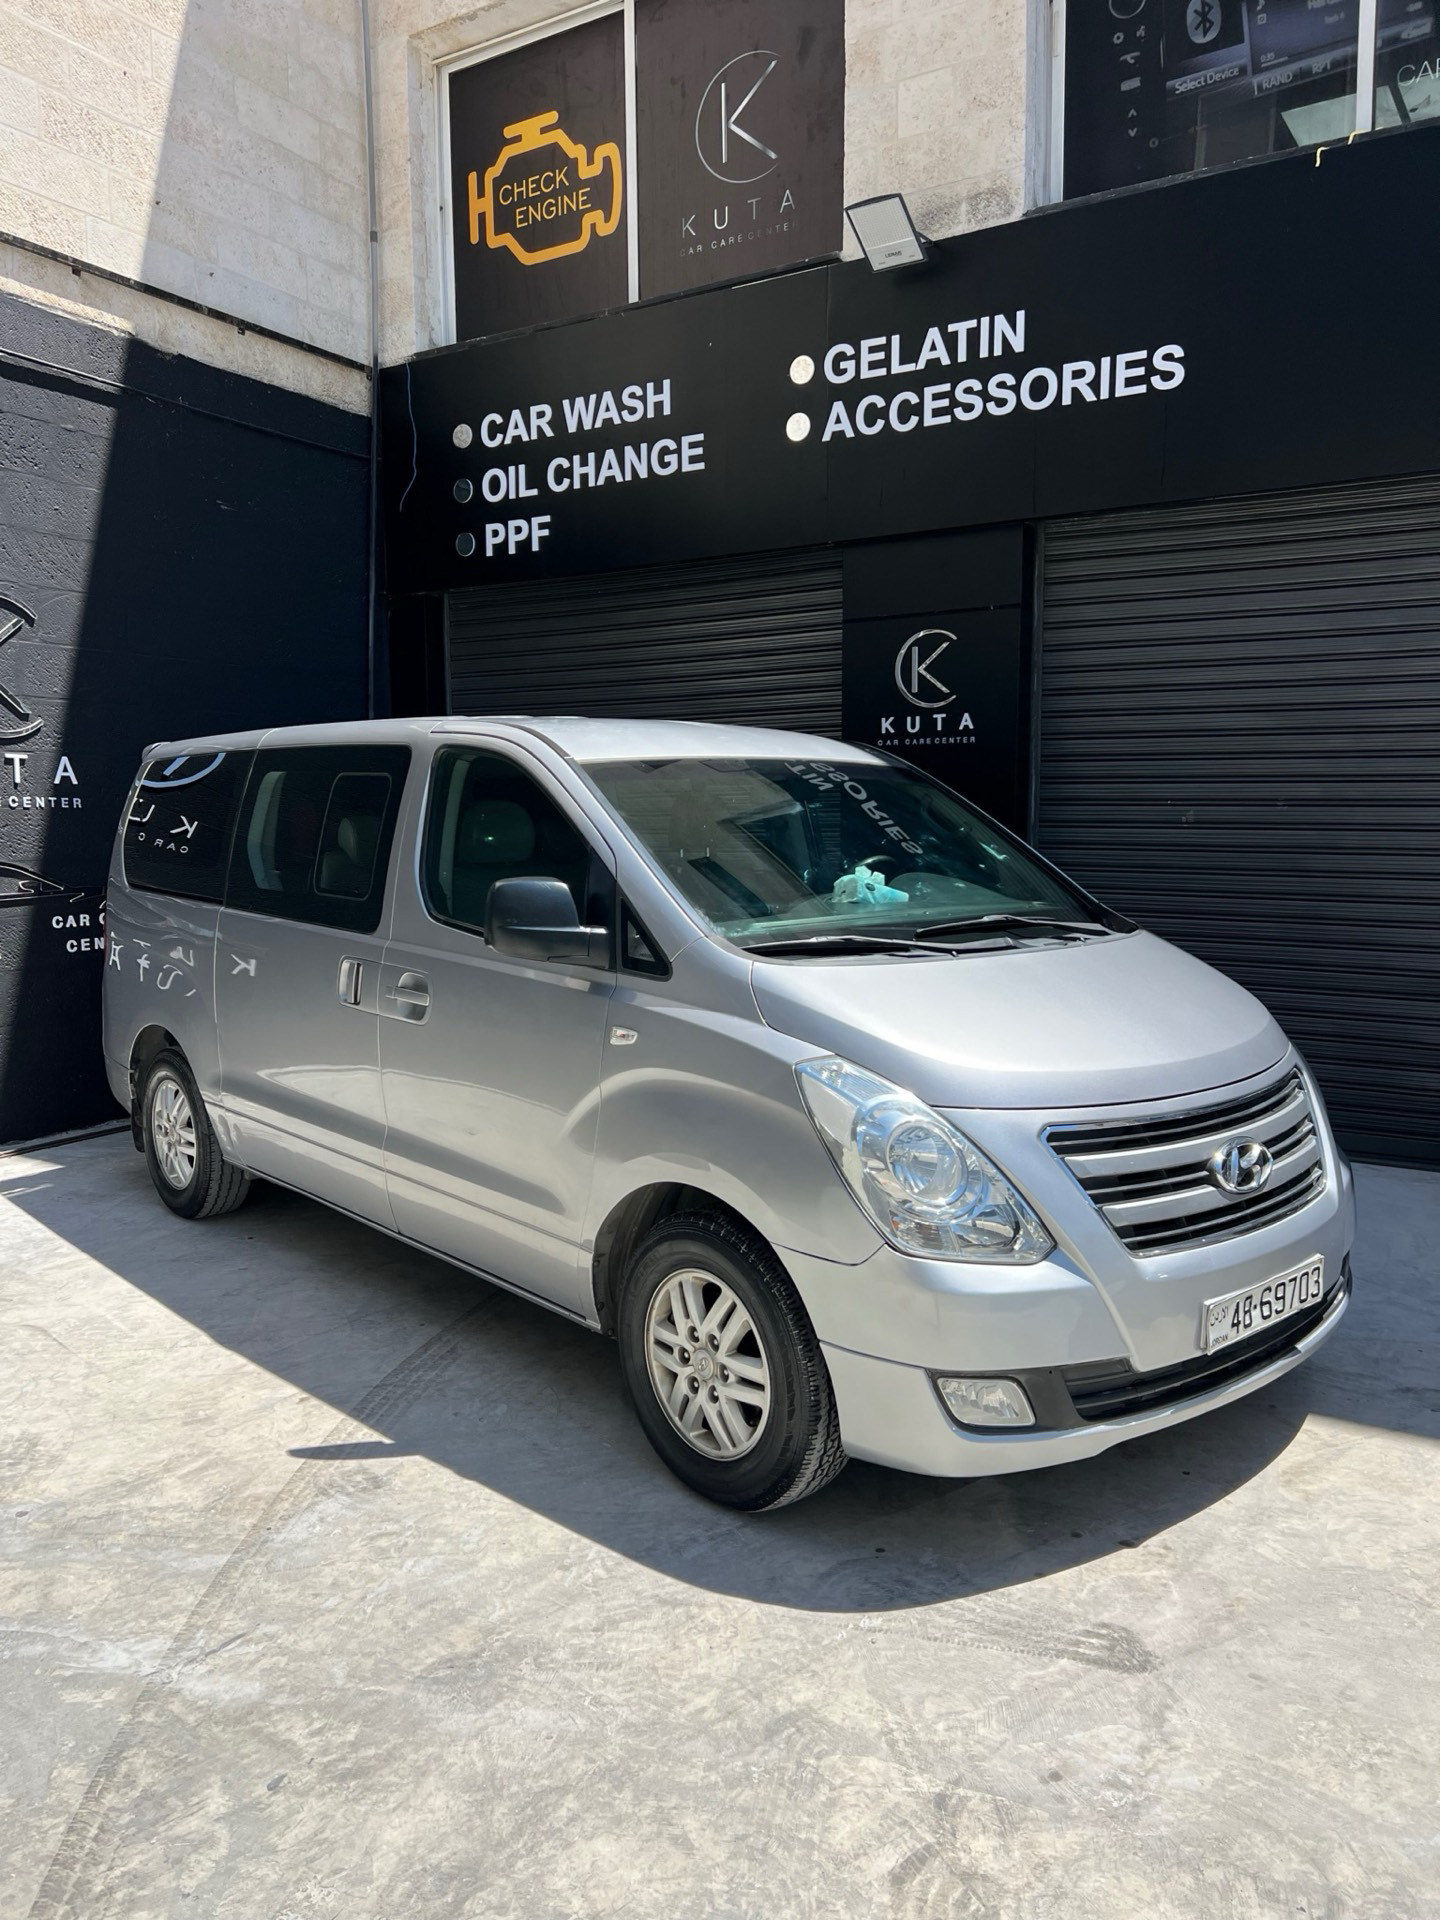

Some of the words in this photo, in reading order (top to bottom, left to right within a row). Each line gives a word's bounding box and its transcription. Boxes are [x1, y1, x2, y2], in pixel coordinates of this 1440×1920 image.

[1174, 77, 1205, 94] Select
[1206, 66, 1240, 84] Device
[1262, 71, 1293, 89] RAND
[1311, 59, 1333, 74] RPT
[498, 165, 570, 206] CHECK
[514, 187, 593, 229] ENGINE
[681, 189, 796, 239] KUTA
[823, 309, 1026, 385] GELATIN
[480, 403, 555, 448] CAR
[561, 378, 672, 434] WASH
[821, 344, 1186, 443] ACCESSORIES
[481, 463, 539, 503] OIL
[546, 432, 706, 493] CHANGE
[484, 514, 551, 557] PPF
[877, 739, 899, 747] CAR
[880, 712, 975, 735] KUTA
[8, 795, 83, 809] CENTER
[51, 913, 91, 930] CAR
